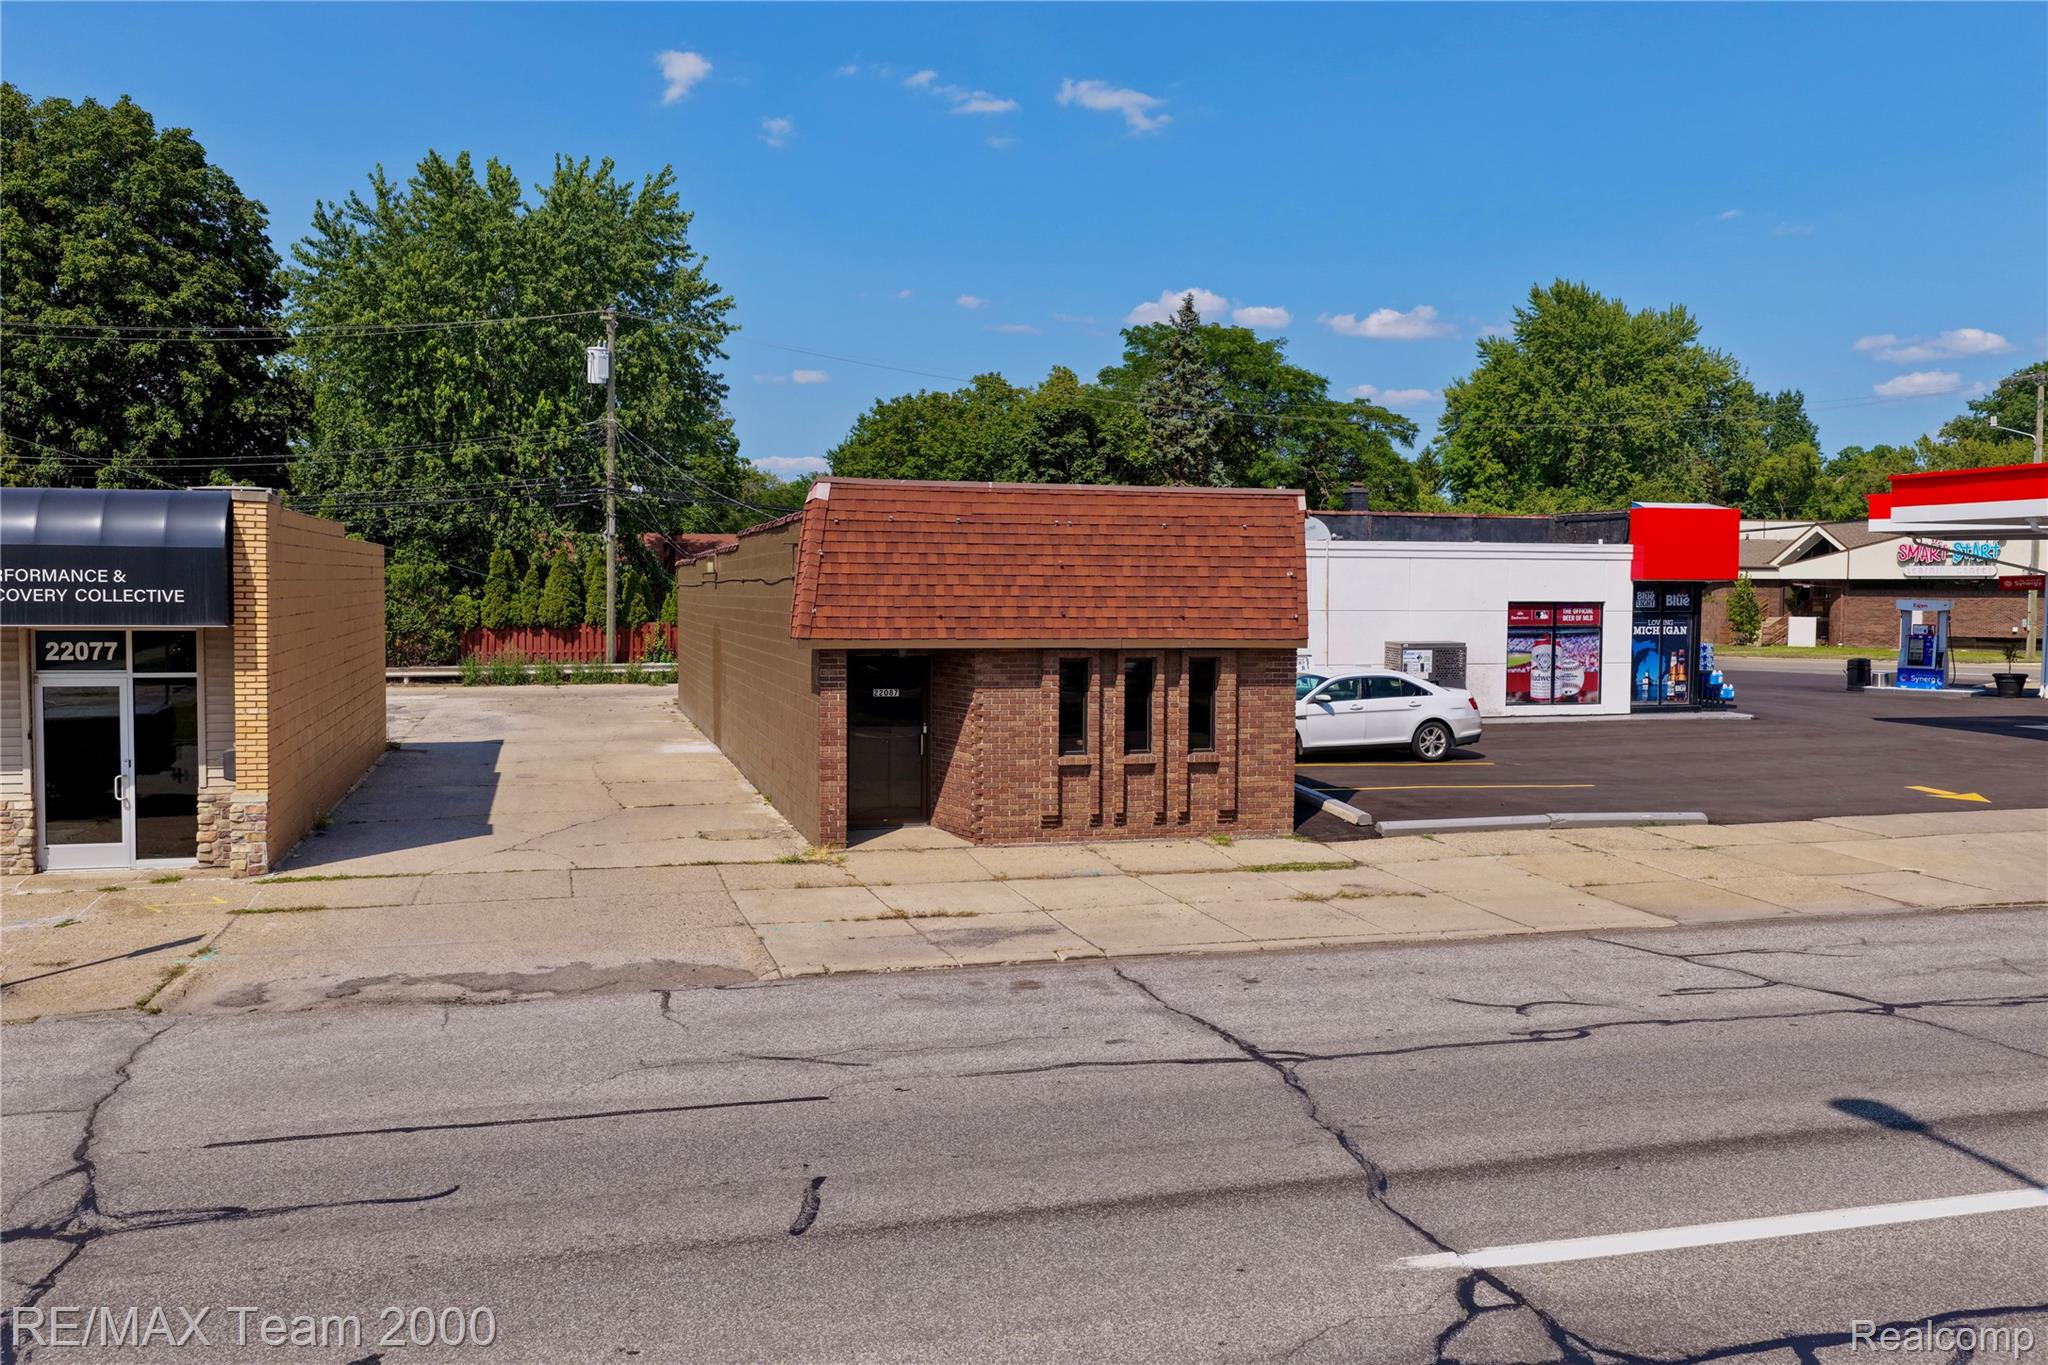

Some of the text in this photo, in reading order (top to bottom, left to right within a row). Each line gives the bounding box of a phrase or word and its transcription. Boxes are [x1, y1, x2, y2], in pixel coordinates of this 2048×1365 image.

[1952, 542, 2001, 565] START
[0, 568, 127, 583] FORMANCE &
[74, 589, 185, 603] COLLECTIVE
[1665, 593, 1690, 607] Blue
[1632, 626, 1688, 635] MICHIGAN
[45, 641, 118, 661] 22077
[873, 689, 899, 697] 22087
